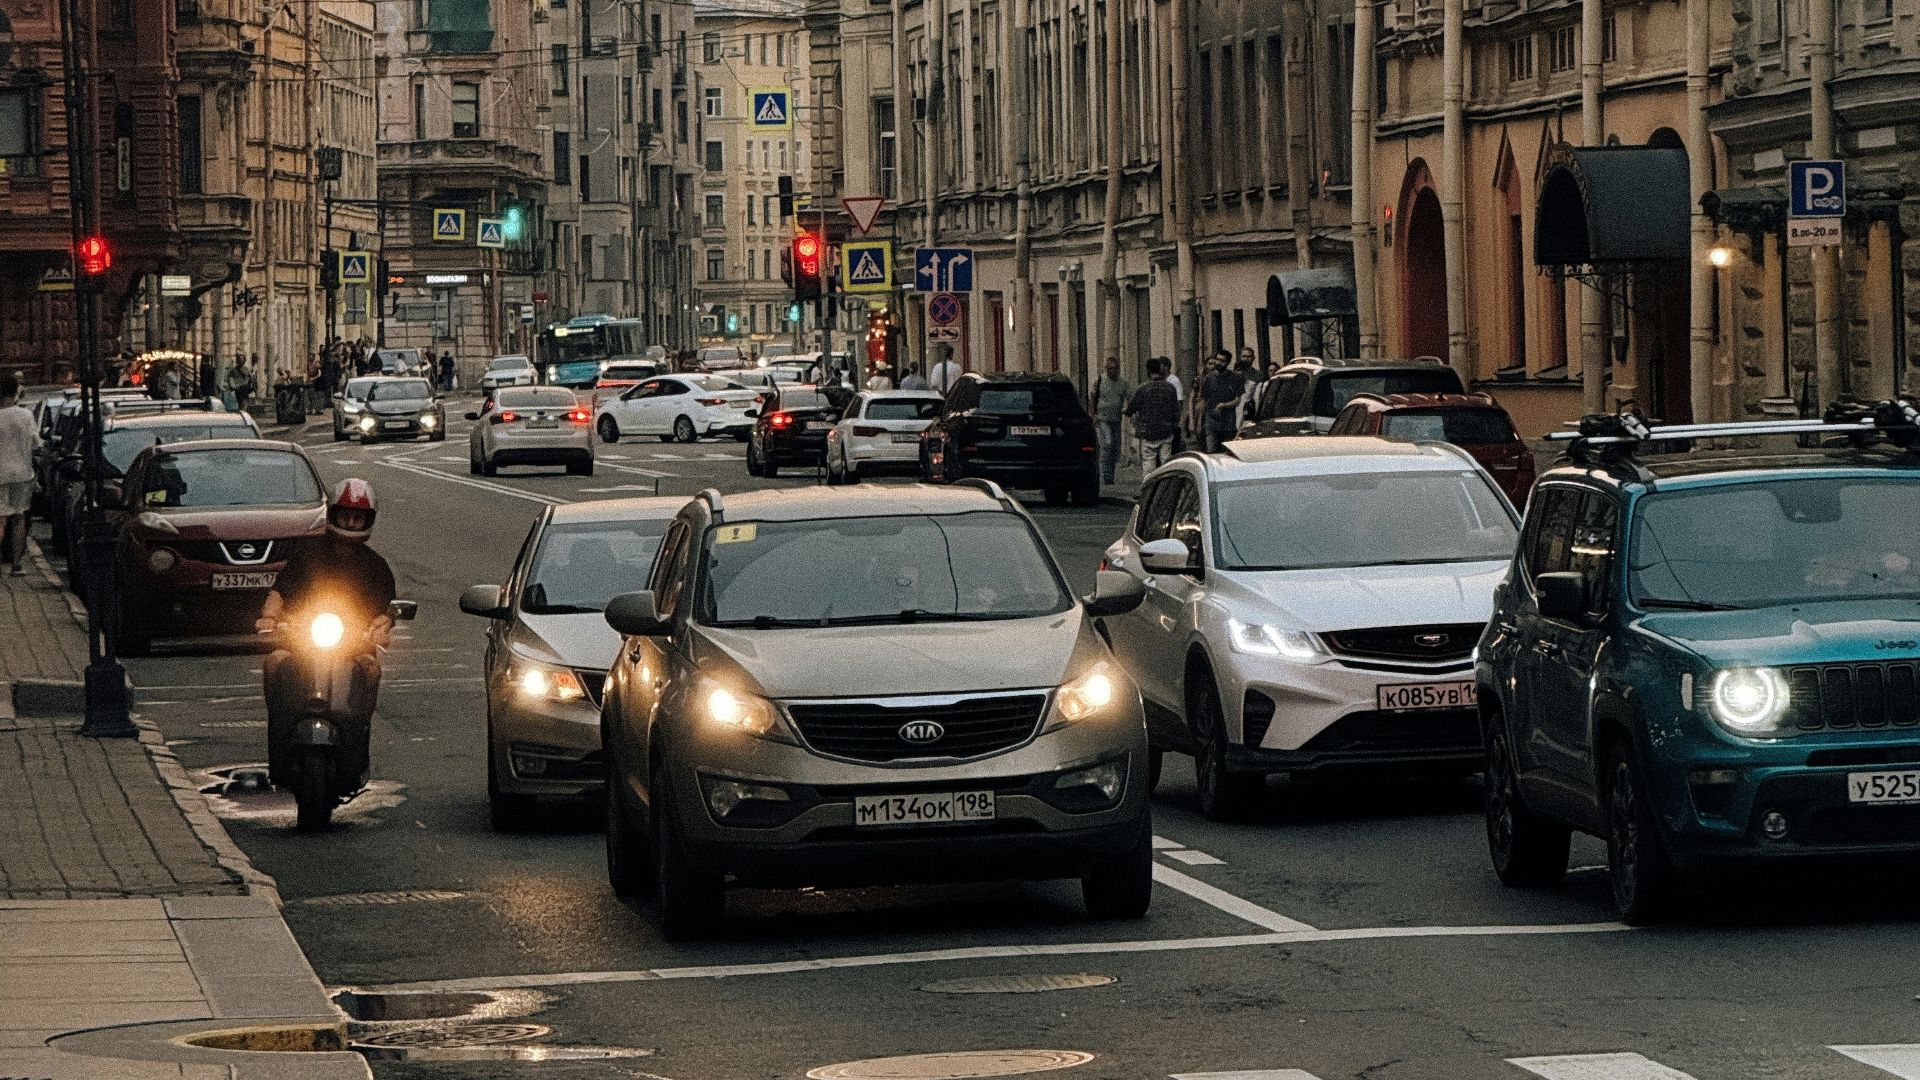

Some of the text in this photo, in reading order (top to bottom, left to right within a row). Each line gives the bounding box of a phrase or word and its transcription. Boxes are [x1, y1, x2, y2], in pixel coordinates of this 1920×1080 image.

[1805, 167, 1834, 211] P
[906, 725, 937, 739] KIA
[1856, 774, 1920, 799] У525
[861, 797, 951, 822] М134ОК
